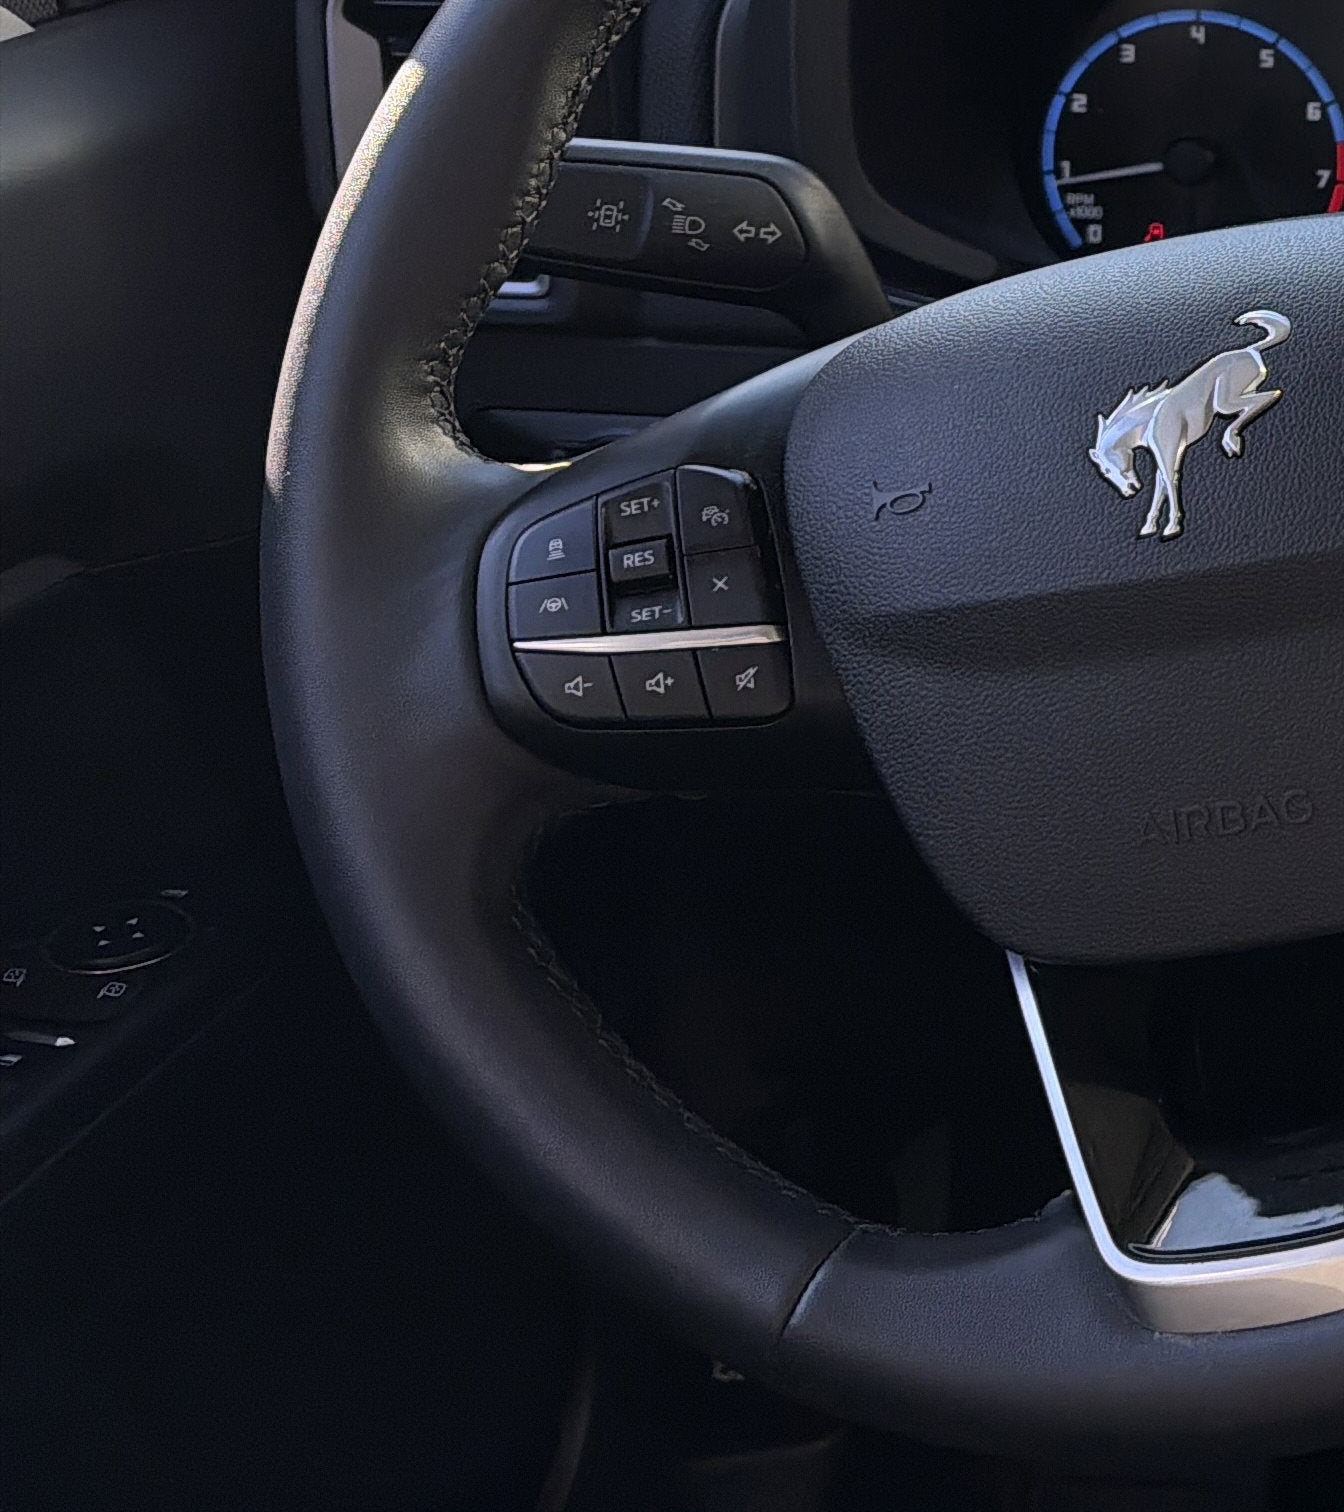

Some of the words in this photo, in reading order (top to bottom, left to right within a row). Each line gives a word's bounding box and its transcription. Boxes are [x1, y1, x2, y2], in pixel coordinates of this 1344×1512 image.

[1190, 25, 1206, 44] 4
[1119, 43, 1136, 63] 3
[1258, 48, 1275, 69] 5
[1070, 93, 1088, 113] 2
[1305, 101, 1322, 121] 6
[1316, 169, 1331, 188] 7
[1066, 192, 1095, 205] RPM
[622, 549, 655, 569] RES
